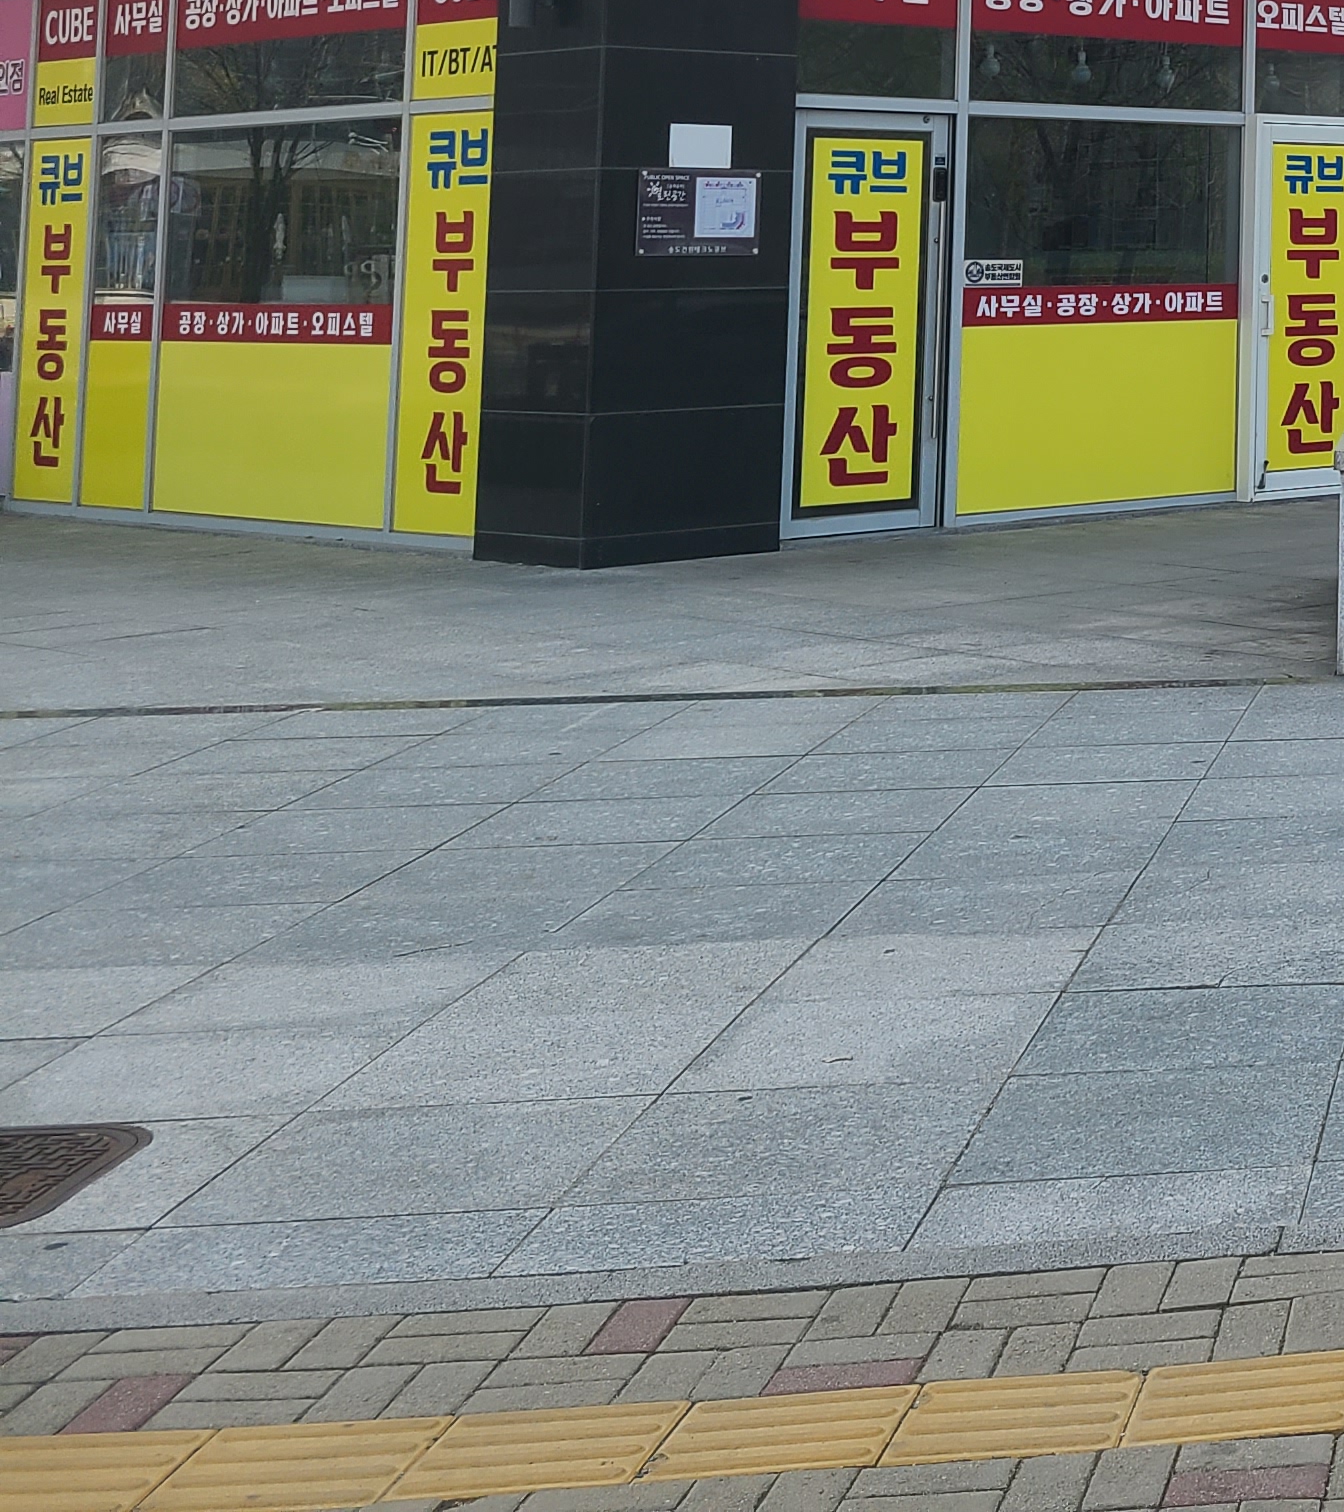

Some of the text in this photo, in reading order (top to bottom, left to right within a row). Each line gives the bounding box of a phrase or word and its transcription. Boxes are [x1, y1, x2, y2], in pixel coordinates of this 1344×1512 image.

[45, 6, 94, 45] CUBE
[114, 0, 163, 35] 사무실
[38, 84, 94, 105] Real Estate
[39, 153, 84, 205] 큐브
[427, 128, 488, 190] 큐브
[827, 149, 908, 195] 큐브
[1284, 154, 1344, 194] 큐브
[30, 223, 73, 468] 부동산
[103, 310, 142, 335] 사무실
[1281, 208, 1340, 455] 부동산
[421, 211, 475, 495] 부동산
[820, 210, 900, 488] 부동산
